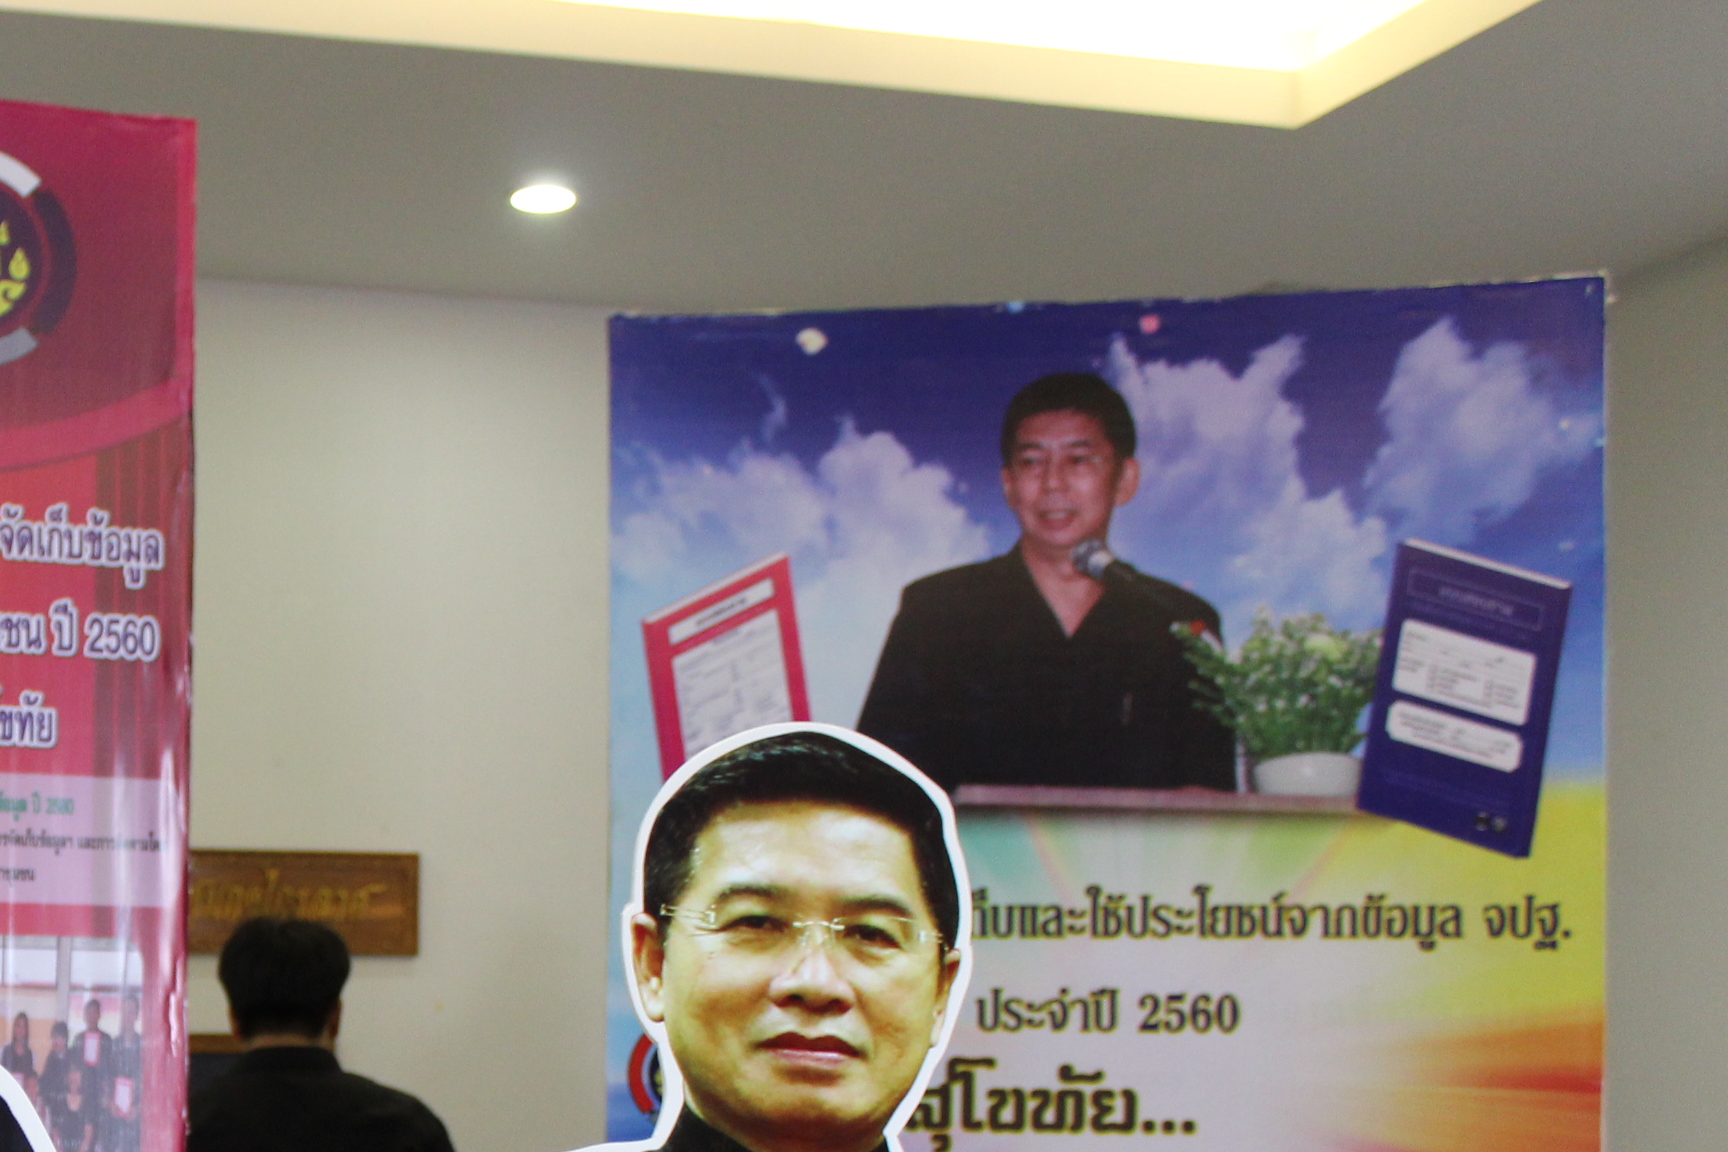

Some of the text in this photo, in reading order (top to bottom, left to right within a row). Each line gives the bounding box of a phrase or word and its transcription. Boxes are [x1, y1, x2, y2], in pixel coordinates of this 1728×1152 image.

[51, 600, 77, 656] ปี
[83, 612, 158, 661] 2560
[1484, 895, 1571, 950] จปฐ.
[977, 987, 1239, 1034] ประจำปี 2560
